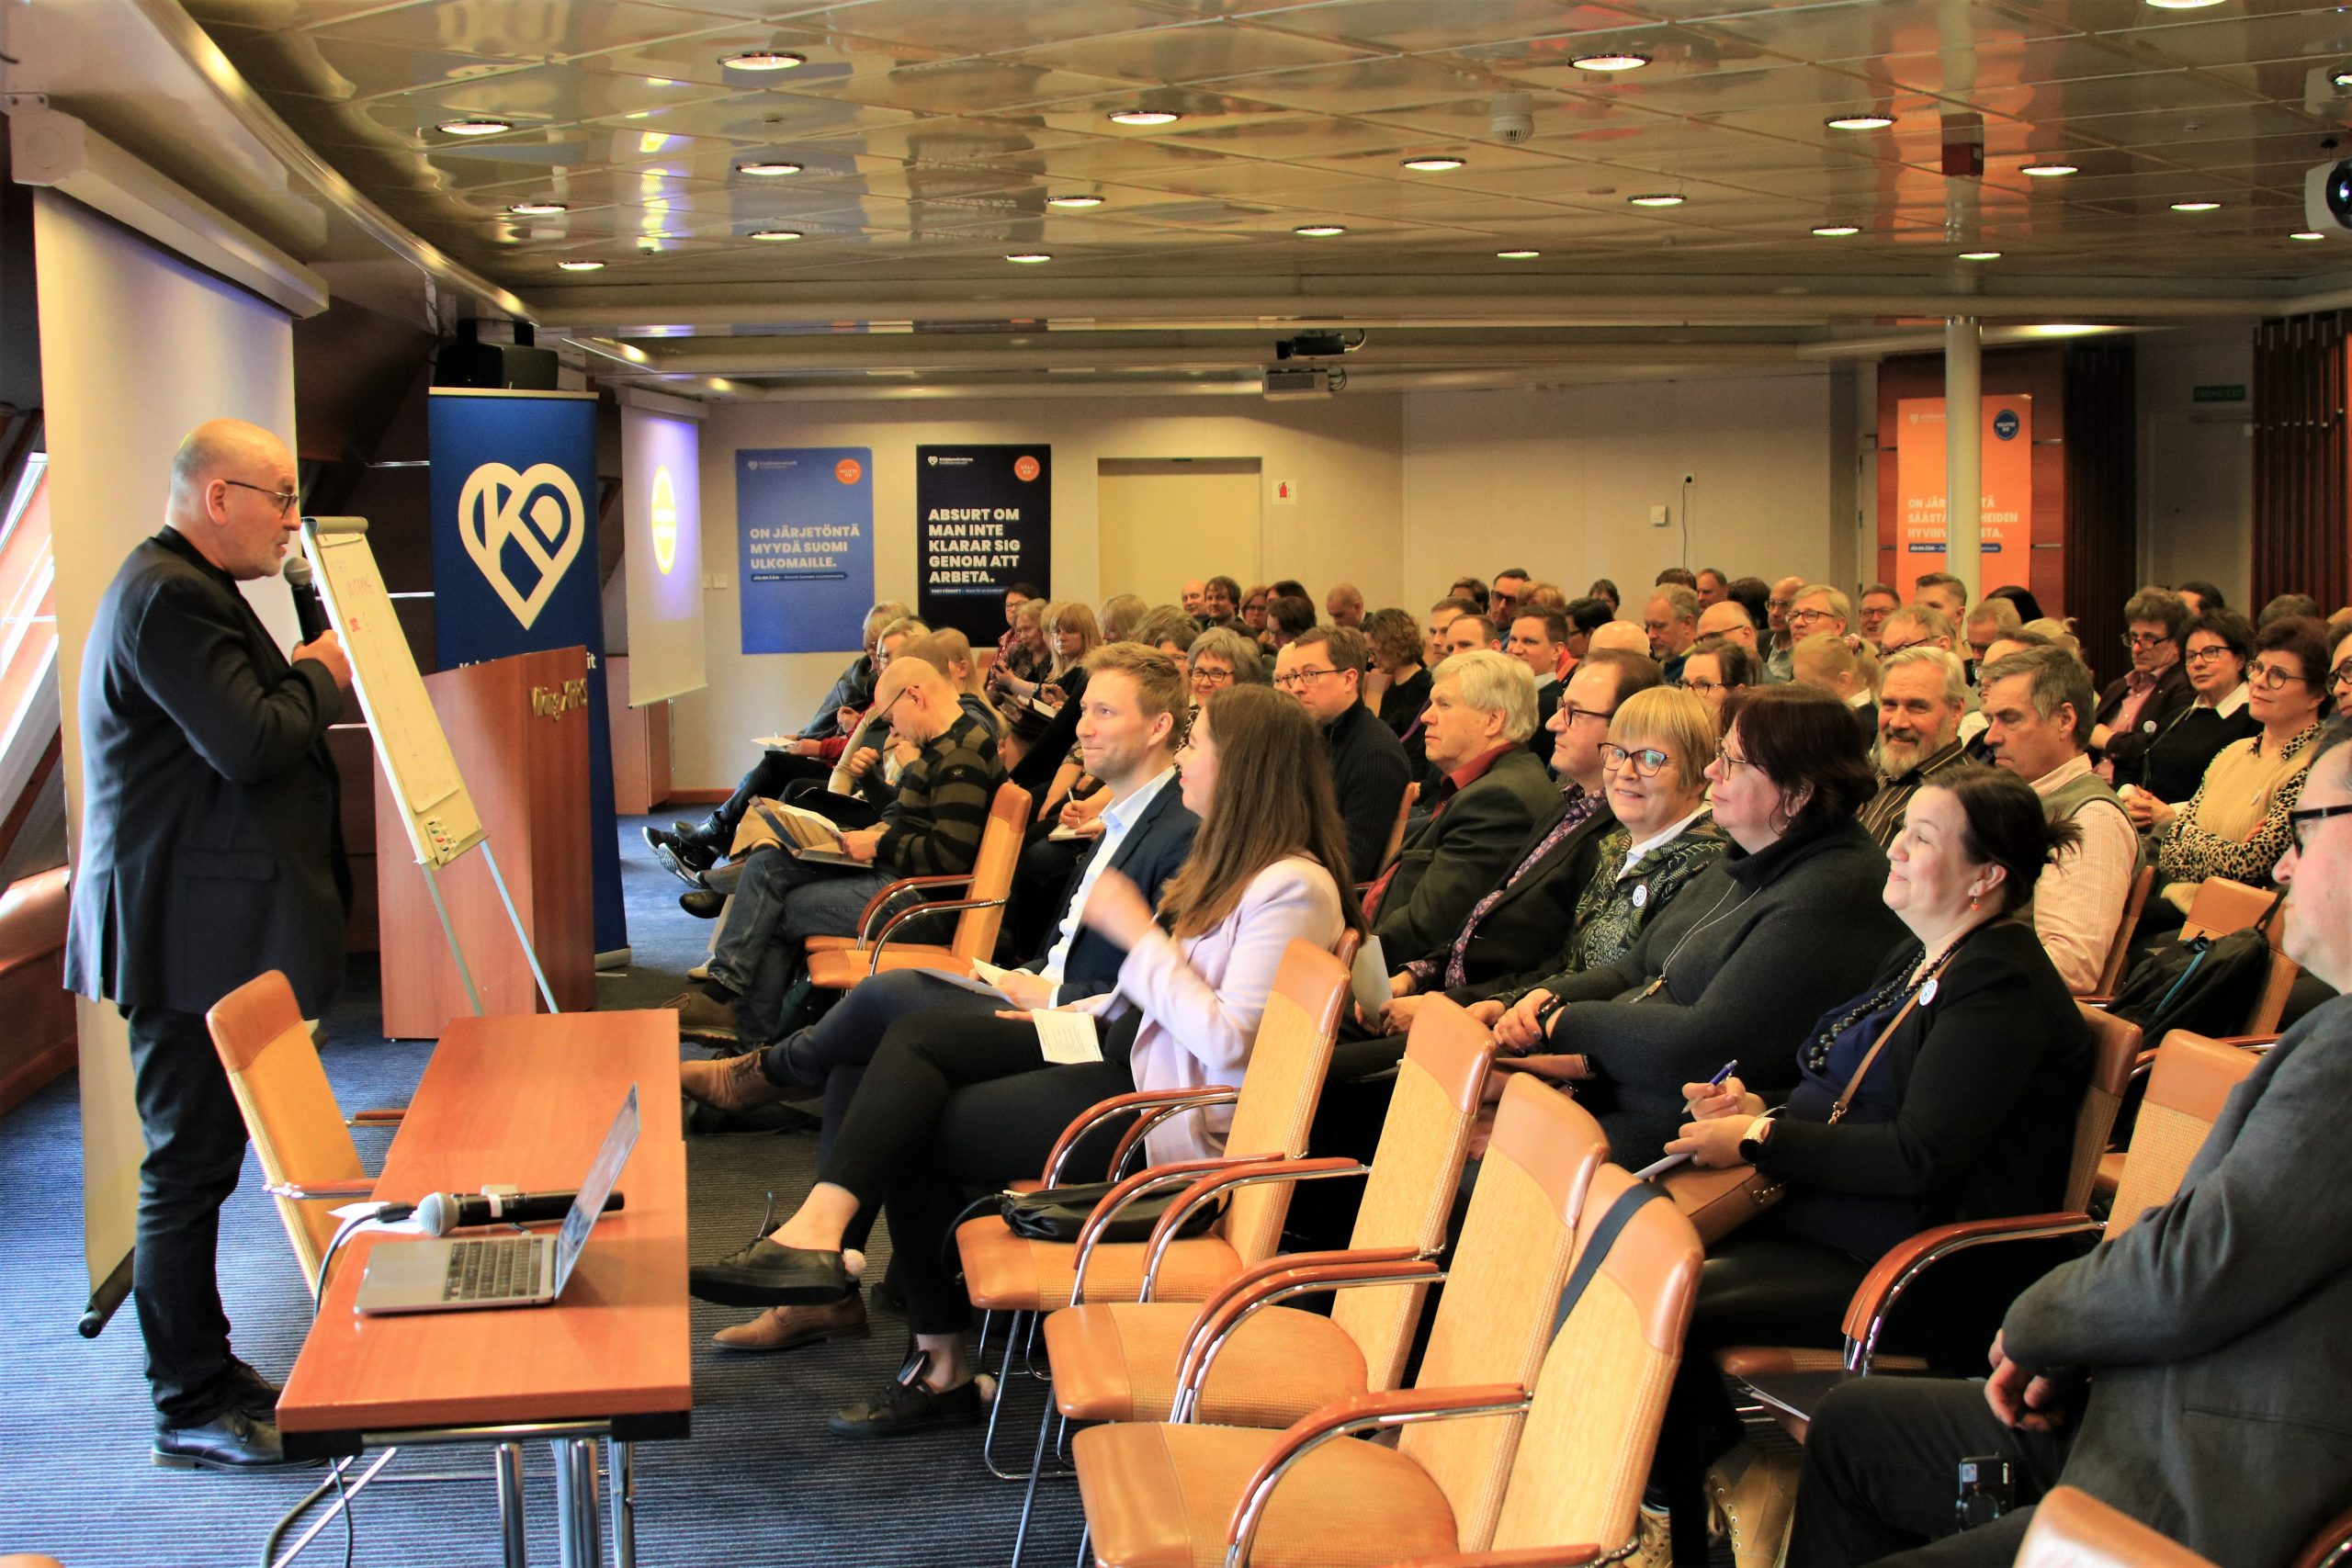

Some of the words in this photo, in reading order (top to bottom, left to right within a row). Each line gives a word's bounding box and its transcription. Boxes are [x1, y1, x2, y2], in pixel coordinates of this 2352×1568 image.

[1907, 499, 1923, 508] ON
[928, 508, 990, 521] ABSURT
[993, 508, 1020, 521] OM
[750, 527, 770, 539] ON
[773, 524, 860, 538] JÄRJETÖNTÄ
[928, 524, 966, 536] MAN
[969, 524, 1003, 536] INTE
[750, 540, 802, 554] MYYDÄ
[804, 541, 848, 553] SUOMI
[928, 539, 991, 552] KLARAR
[994, 539, 1021, 552] SIG
[751, 557, 837, 570] ULKOMAILLE.
[928, 555, 987, 568] GENOM
[989, 555, 1020, 568] ATT
[929, 570, 995, 583] ARBETA.
